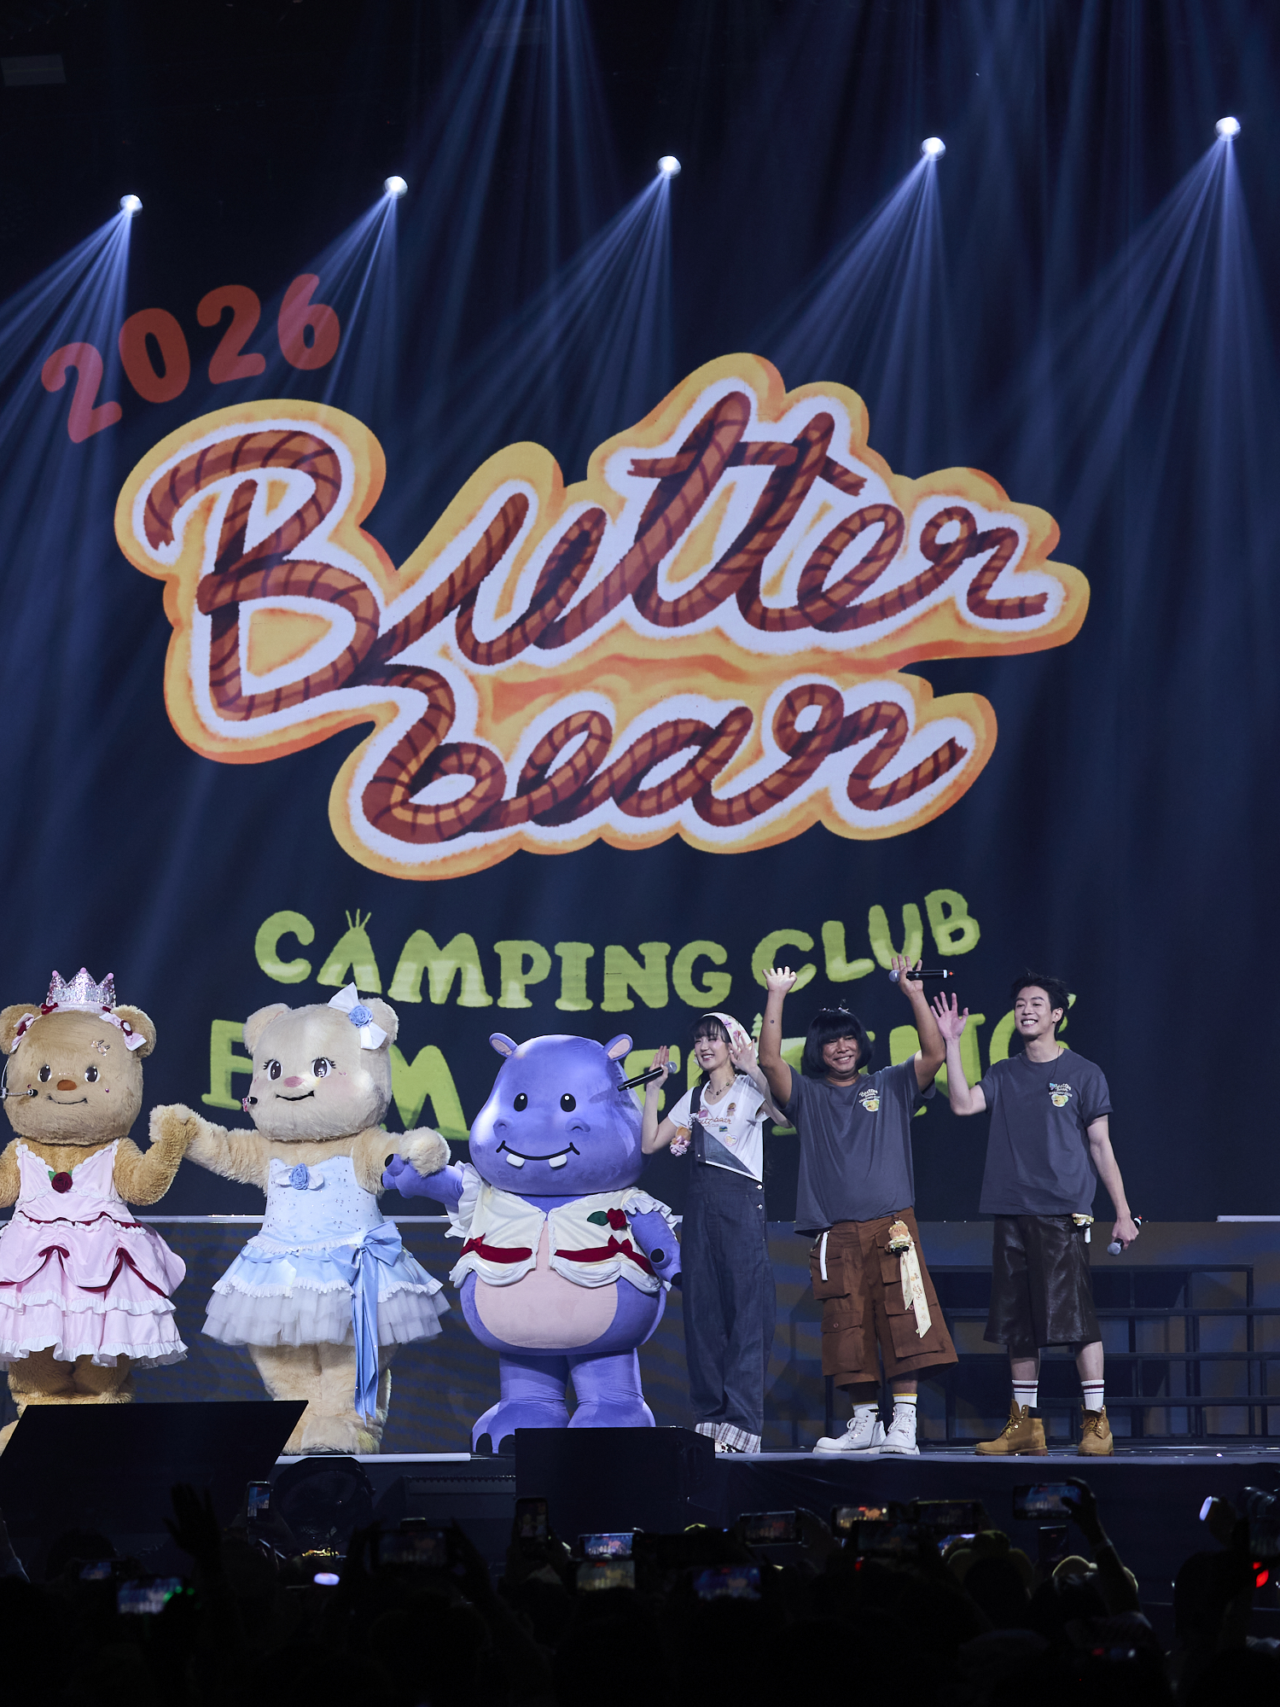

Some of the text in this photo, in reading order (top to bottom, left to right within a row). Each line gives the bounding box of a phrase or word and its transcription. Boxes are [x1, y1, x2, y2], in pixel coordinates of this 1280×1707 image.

[40, 273, 341, 444] 2026
[142, 389, 1050, 723] Butter
[360, 662, 969, 845] bear
[254, 888, 982, 1013] CAMPING CLUB
